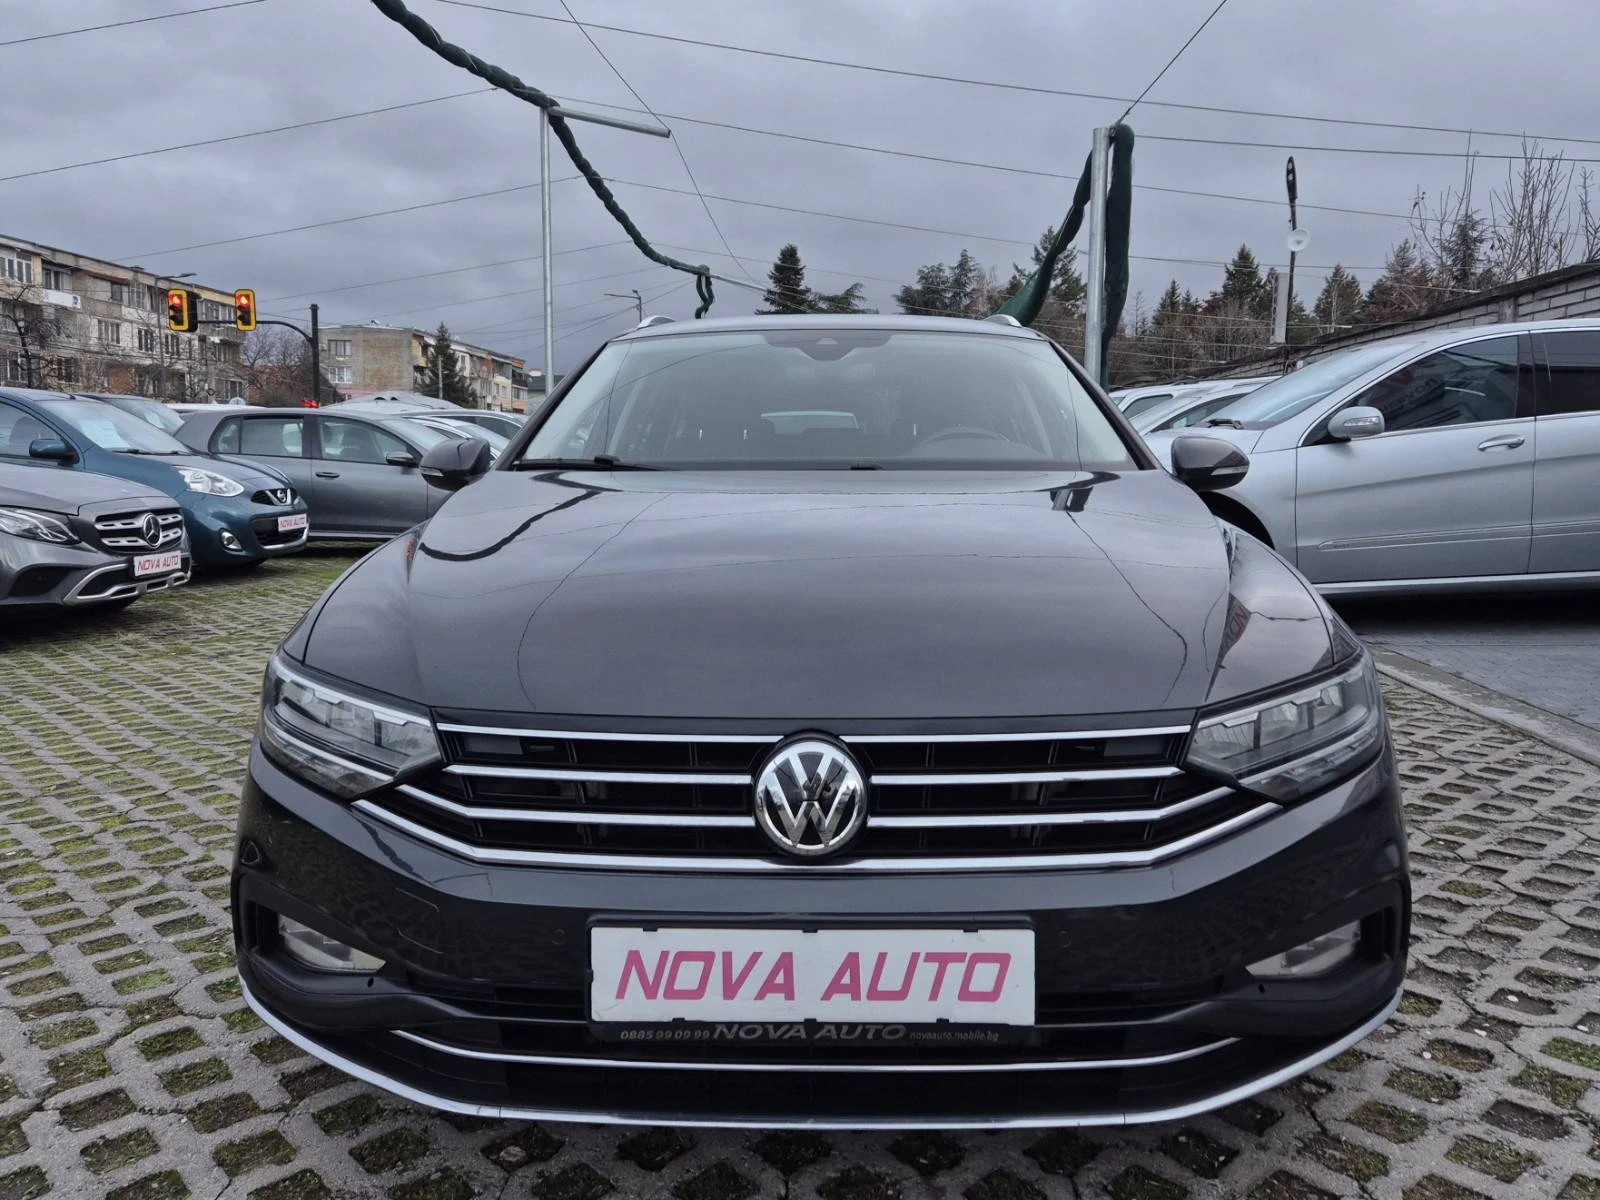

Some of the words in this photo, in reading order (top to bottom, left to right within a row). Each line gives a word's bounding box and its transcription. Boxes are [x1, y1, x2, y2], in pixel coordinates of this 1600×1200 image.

[138, 558, 161, 572] NOVA
[162, 554, 179, 568] AUTO
[614, 949, 796, 1002] NOVA
[820, 950, 1013, 1003] AUTO
[620, 1030, 654, 1040] 0885
[712, 1023, 807, 1040] NOVA
[814, 1023, 907, 1041] AUTO
[909, 1029, 1000, 1042] novaauto.mobile.bg
